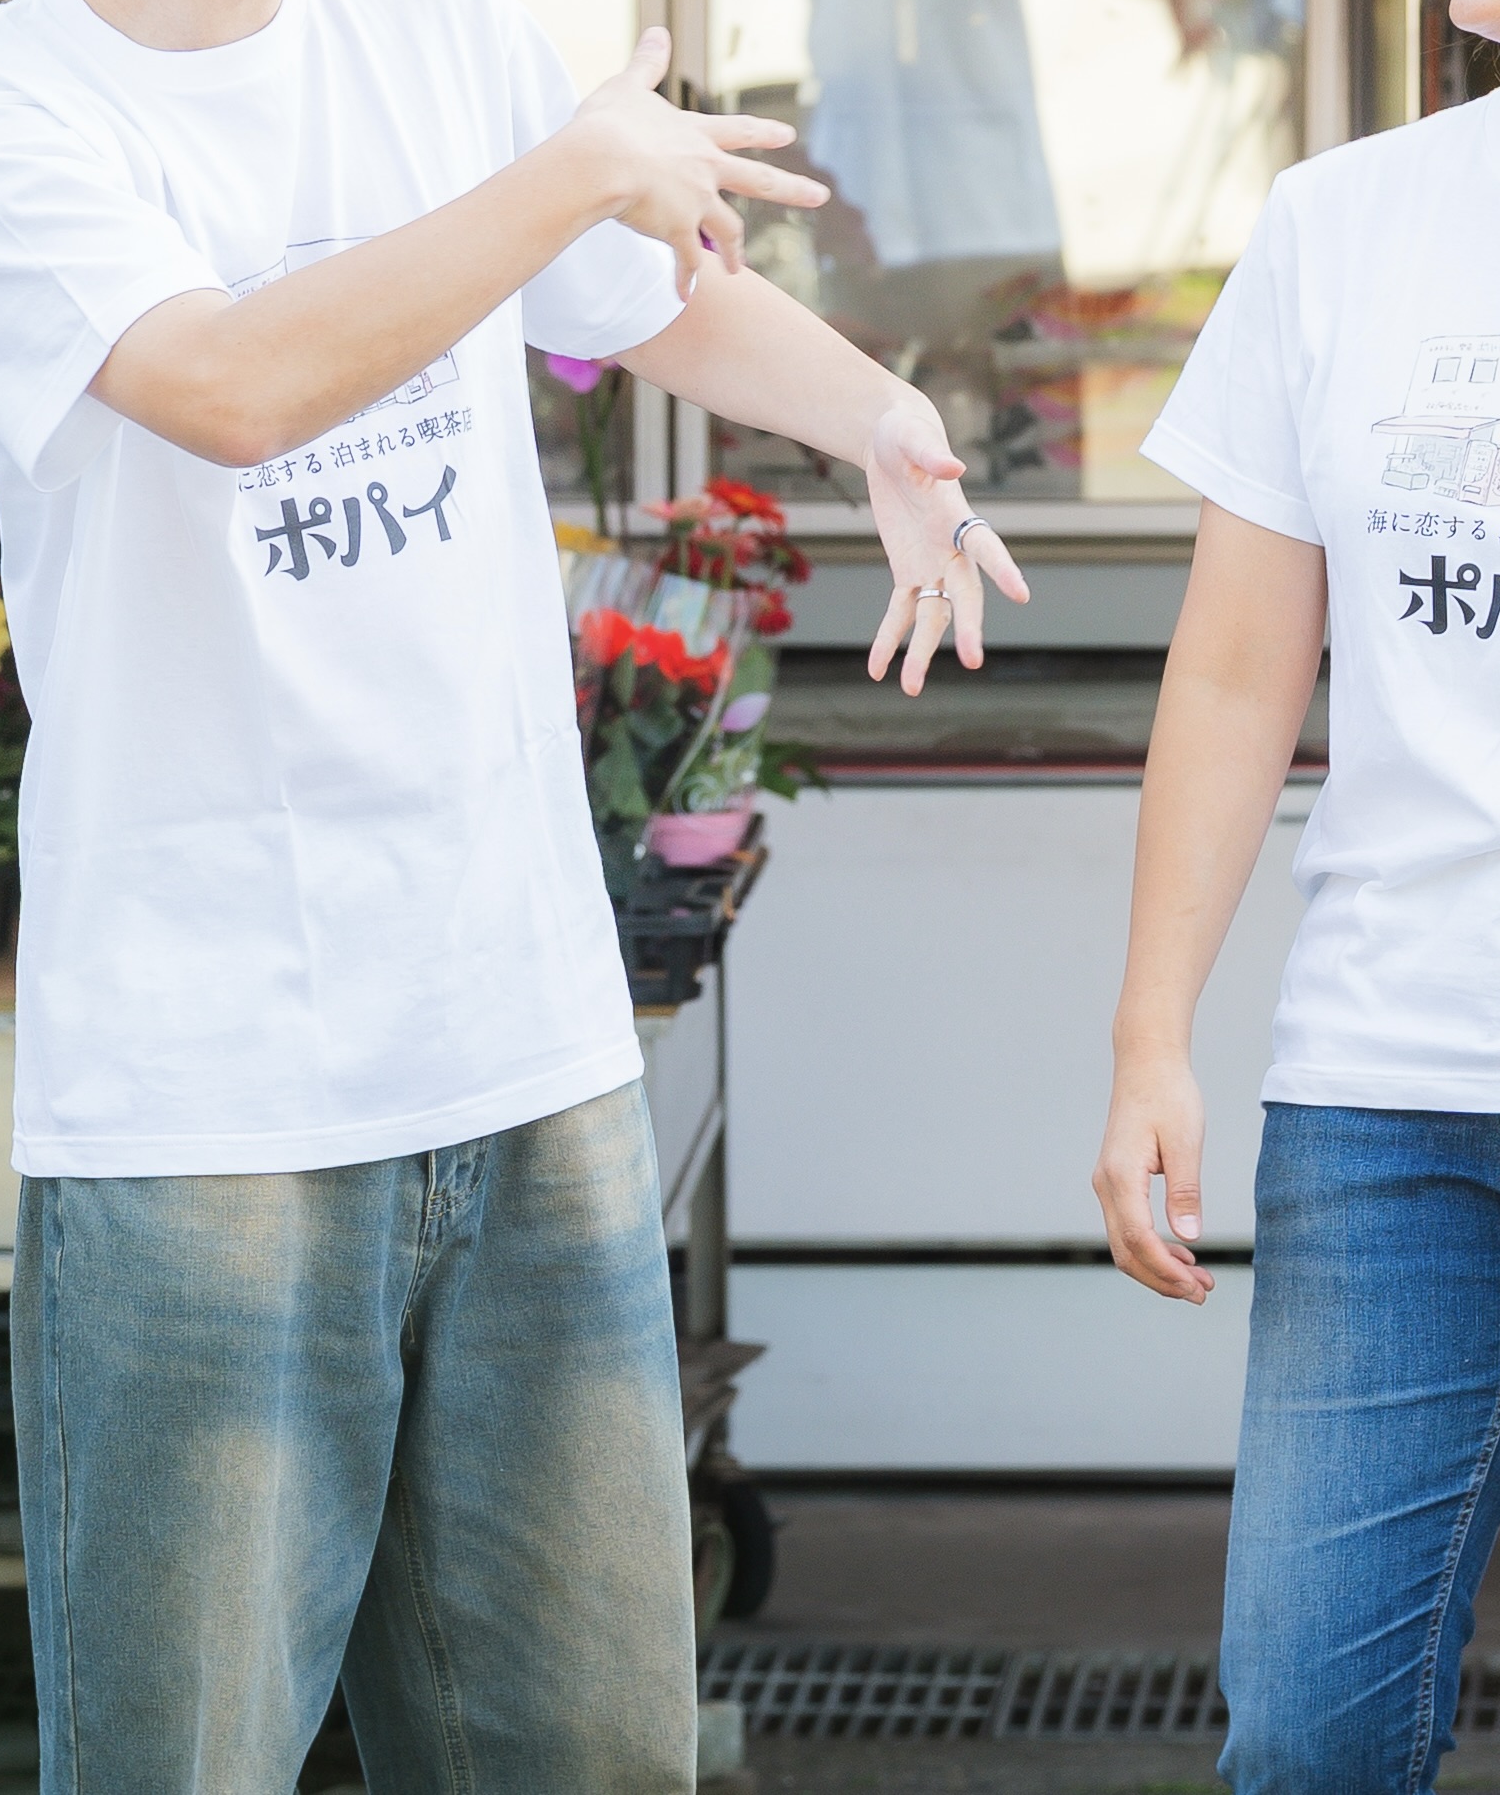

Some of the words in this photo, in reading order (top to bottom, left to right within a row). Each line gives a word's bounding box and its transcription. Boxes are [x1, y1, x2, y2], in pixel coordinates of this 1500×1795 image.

[254, 463, 457, 581] ポパイ
[1366, 508, 1487, 542] 海に恋する
